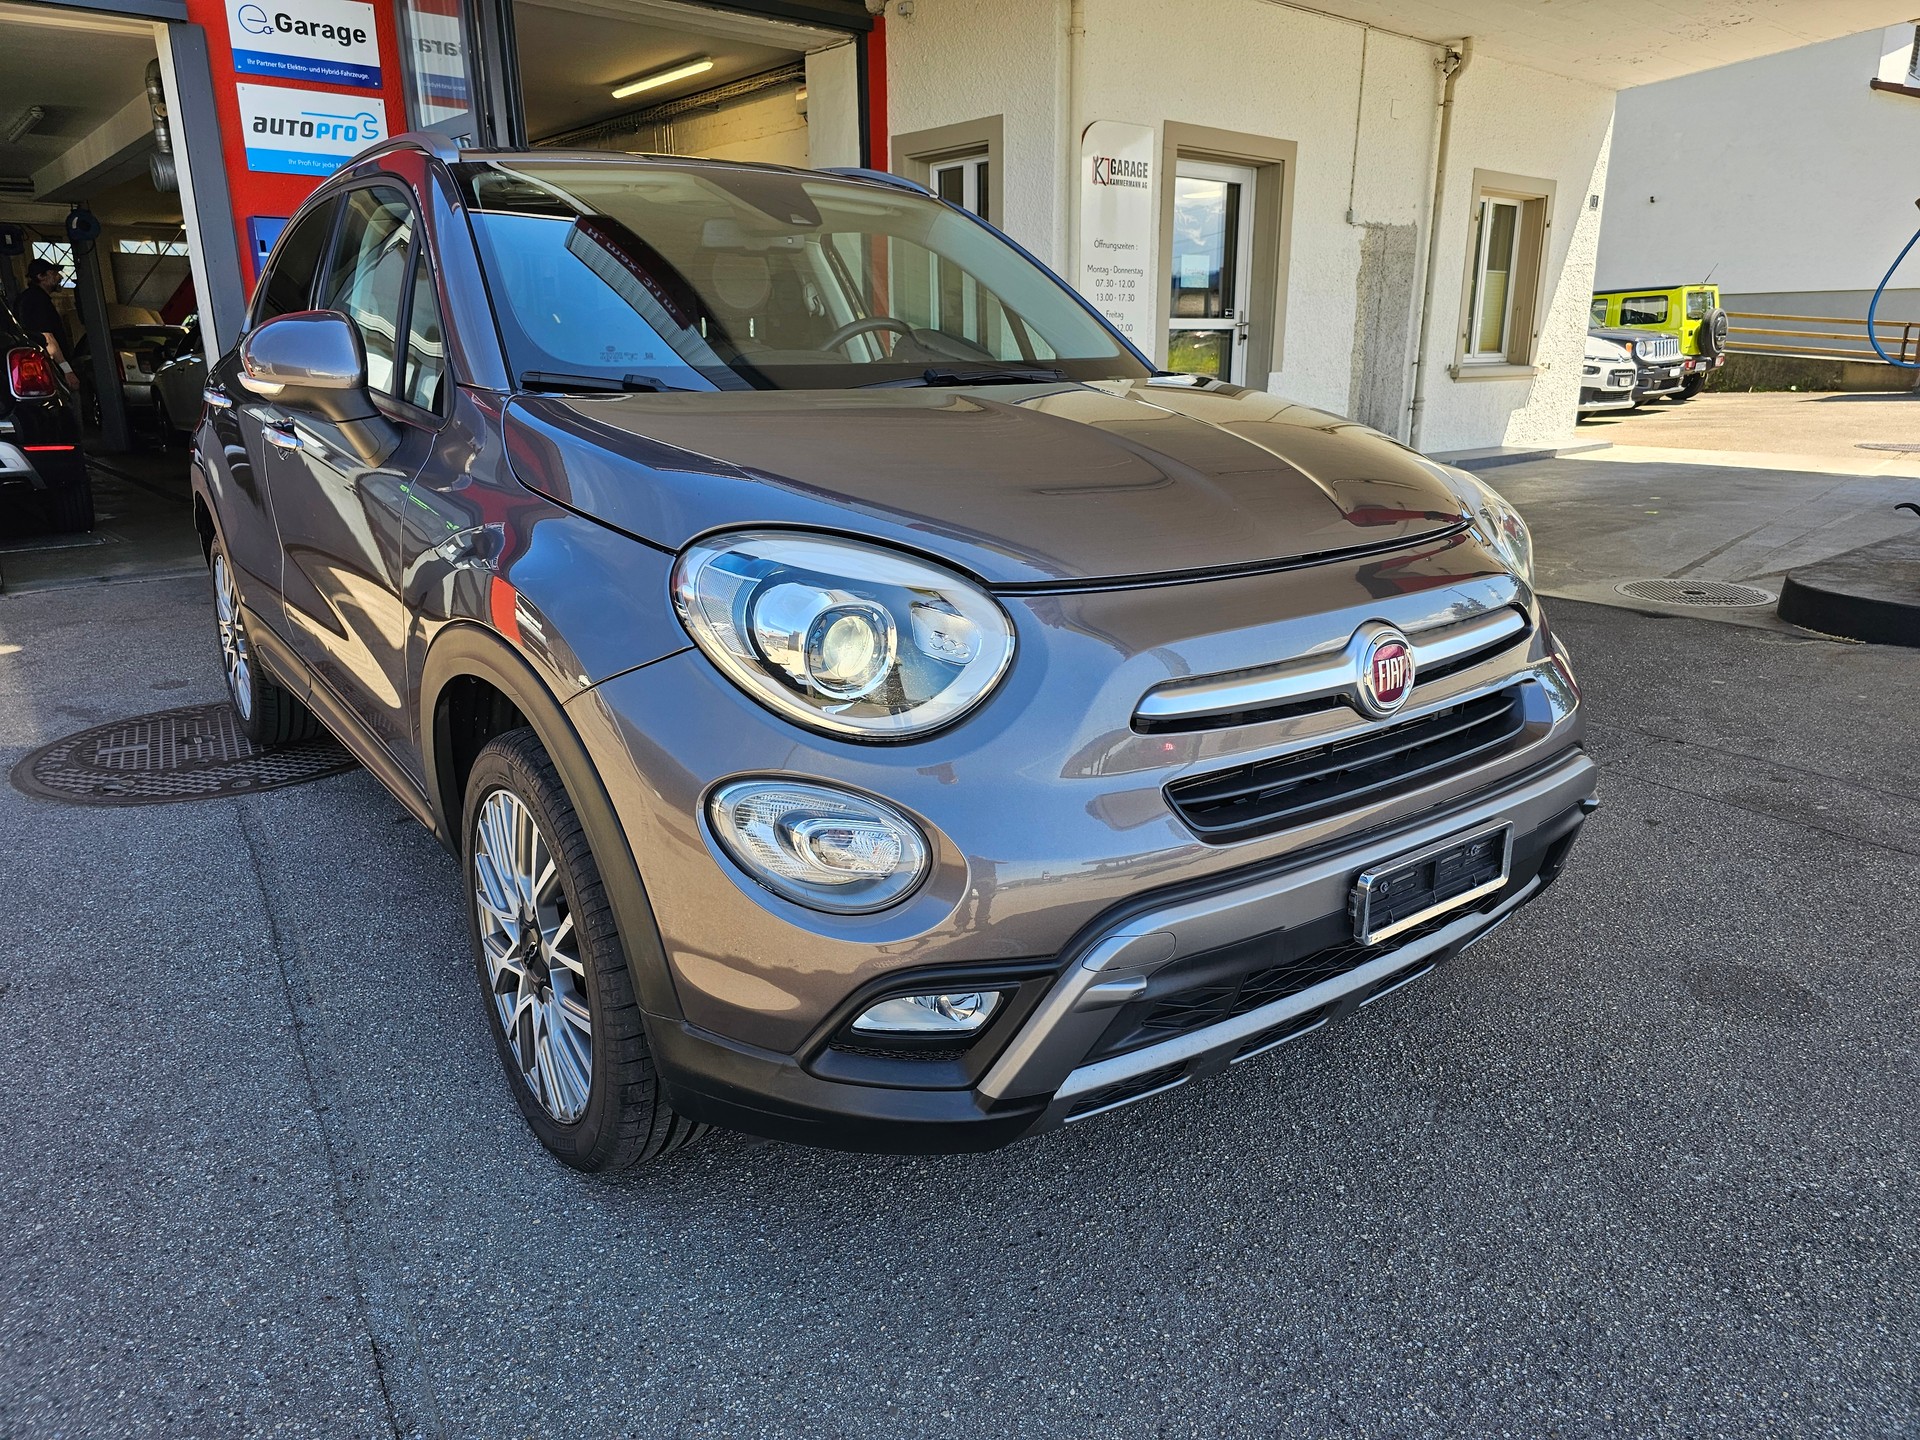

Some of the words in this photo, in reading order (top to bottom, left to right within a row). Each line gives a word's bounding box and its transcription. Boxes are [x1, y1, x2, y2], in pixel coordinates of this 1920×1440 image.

[274, 12, 367, 47] Garage
[256, 59, 277, 68] Partner
[277, 61, 287, 69] für
[287, 62, 309, 72] Elektro-
[309, 66, 321, 74] und
[321, 67, 370, 80] Hybrid-Fahrzeuge.
[322, 161, 335, 169] jede
[1110, 158, 1149, 179] GARAGE
[1109, 178, 1141, 189] KAMMERMANN
[1141, 181, 1148, 190] AG
[1094, 238, 1135, 252] Öffnungszeiten
[1087, 265, 1109, 276] Montag
[1114, 266, 1144, 278] Donnerstag
[1096, 279, 1114, 288] 07.30
[1119, 280, 1136, 289] 12.00
[1097, 293, 1114, 302] 13.00
[1119, 294, 1135, 302] 17.30
[1106, 310, 1124, 321] Freitag
[1377, 655, 1405, 693] FIAT
